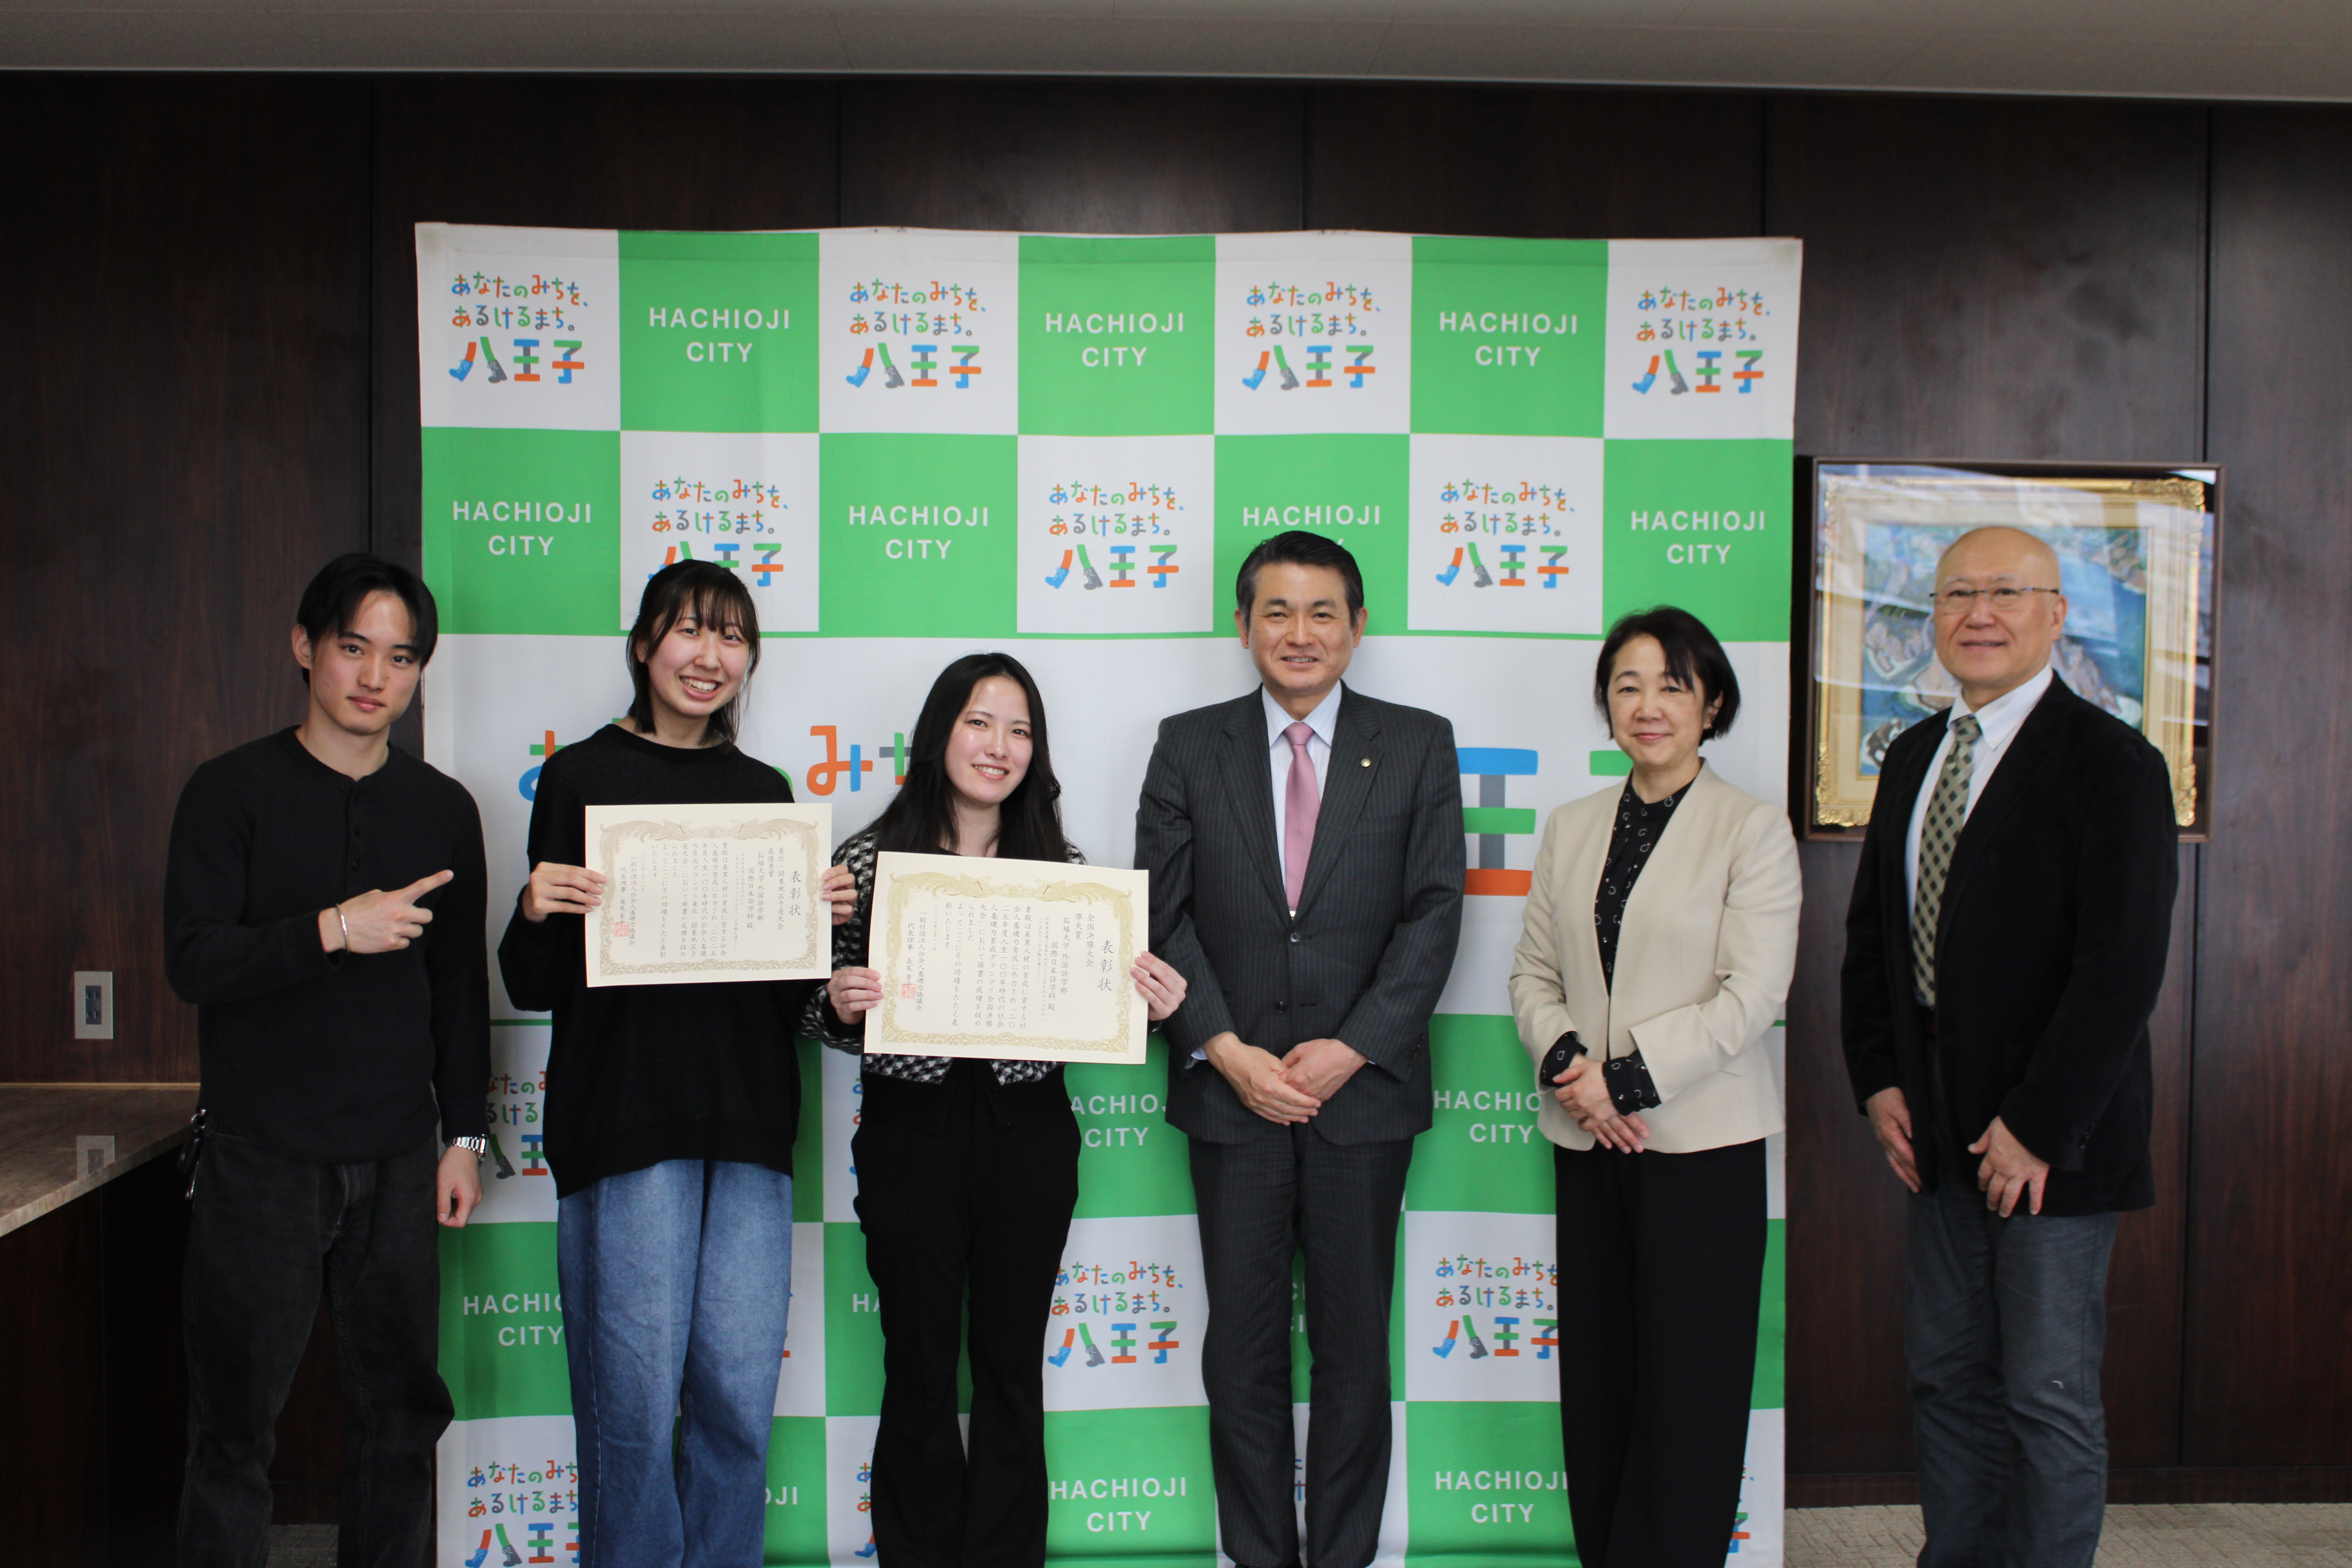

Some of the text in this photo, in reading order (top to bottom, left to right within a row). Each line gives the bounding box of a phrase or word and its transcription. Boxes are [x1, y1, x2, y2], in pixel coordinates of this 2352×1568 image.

[451, 271, 587, 307] あなたのみちを、
[849, 278, 985, 312] あなたのみちを、
[1247, 281, 1380, 312] あなたのみちを、
[1638, 286, 1770, 316] あなたのみちを、
[452, 305, 575, 332] あるけるまち。
[649, 308, 789, 329] HACHIOJI
[849, 311, 972, 336] あるけるまち。
[1046, 313, 1184, 334] HACHIOJI
[1246, 313, 1367, 338] あるけるまち。
[1440, 312, 1578, 334] HACHIOJI
[1637, 318, 1756, 342] あるけるまち。
[449, 336, 584, 384] 八王子
[686, 342, 753, 362] CITY
[1082, 347, 1148, 367] CITY
[1475, 346, 1541, 366] CITY
[846, 343, 982, 389] 八王子
[1242, 345, 1376, 391] 八王子
[1632, 349, 1764, 395] 八王子
[652, 476, 788, 509] あなたのみちを、
[1049, 480, 1183, 510] あなたのみちを、
[1441, 479, 1575, 512] あなたのみちを、
[453, 501, 591, 523] HACHIOJI
[652, 510, 775, 534] あるけるまち。
[849, 505, 989, 526] HACHIOJI
[1049, 512, 1170, 537] あるけるまち。
[1243, 505, 1380, 526] HACHIOJI
[1440, 511, 1561, 537] あるけるまち。
[1631, 510, 1765, 531] HACHIOJI
[488, 535, 554, 555] CITY
[885, 539, 952, 559] CITY
[1667, 544, 1731, 564] CITY
[1045, 544, 1180, 590] 八王子
[1436, 542, 1570, 589] 八王子
[789, 870, 801, 916] 表彰状
[906, 922, 915, 950] 代表理事
[1086, 914, 1095, 967] 全国決勝大会
[916, 912, 927, 1011] 一般社団法人社会人基礎力協議会
[951, 903, 964, 1026] よってここにその功績をたたえ表
[985, 905, 998, 1027] 人基礎力育成グランプリ全国決勝
[1020, 906, 1032, 1029] 貴殿は産業人材の育成に資する社
[1049, 942, 1058, 1000] 国際日本語学科
[1060, 953, 1070, 995] 外国語学部
[1098, 940, 1114, 991] 表彰状
[1071, 1094, 1166, 1115] ACHIO
[1084, 1127, 1149, 1148] CITY
[1470, 1123, 1534, 1143] CITY
[1051, 1290, 1171, 1317] あるけるまち。
[1436, 1285, 1554, 1311] あるけるまち。
[498, 1326, 564, 1347] CITY
[1047, 1321, 1179, 1368] 八王子
[1050, 1477, 1187, 1500] HACHIOJI
[1435, 1470, 1568, 1490] HACHIOJI
[1086, 1512, 1151, 1533] CITY
[1471, 1503, 1534, 1523] CITY
